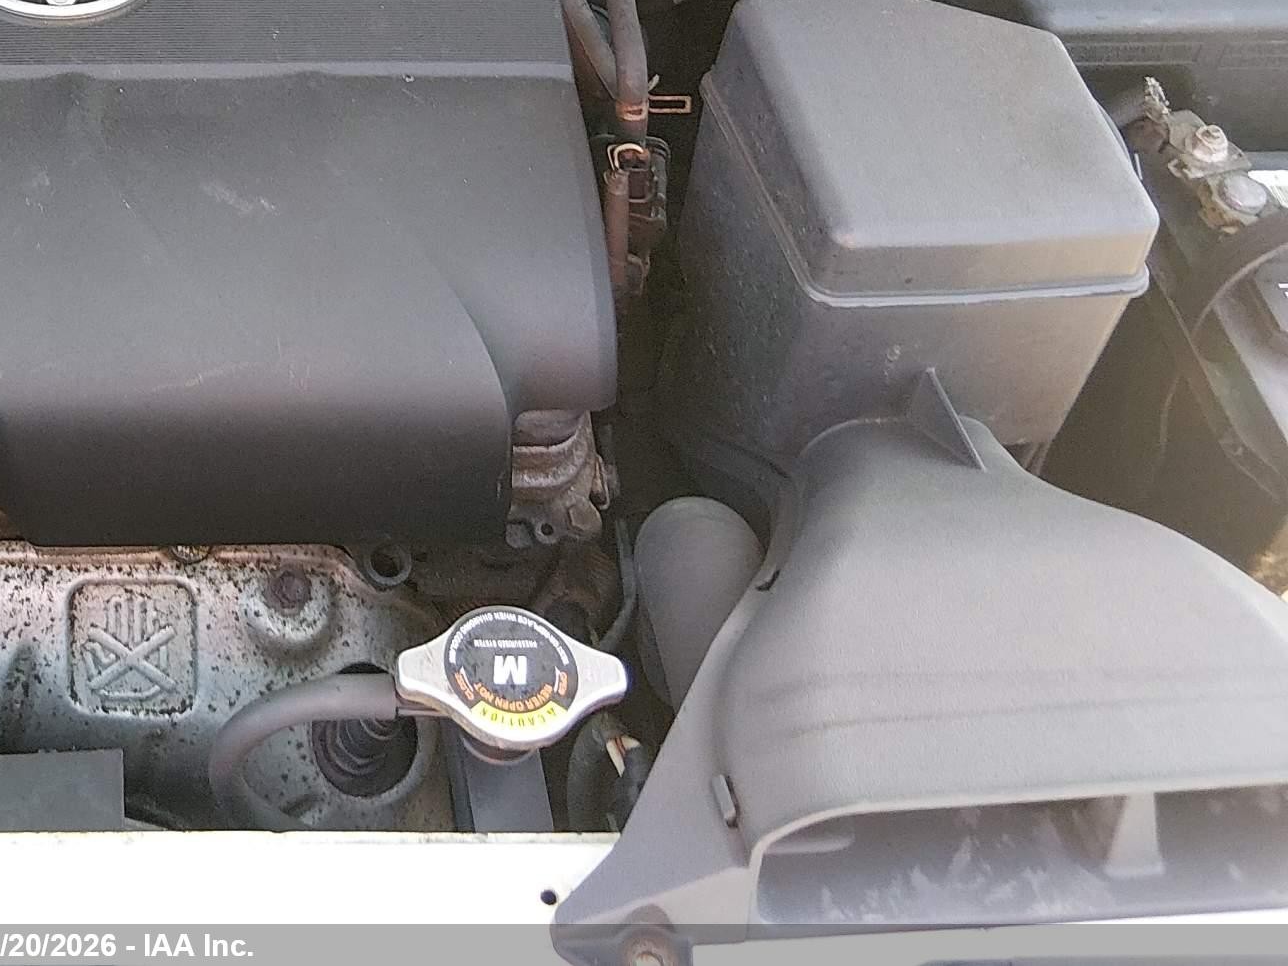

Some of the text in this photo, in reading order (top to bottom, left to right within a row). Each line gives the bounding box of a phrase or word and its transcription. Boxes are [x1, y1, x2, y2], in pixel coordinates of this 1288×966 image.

[493, 611, 517, 622] WHEN
[493, 655, 527, 685] M
[495, 696, 524, 712] OPEN
[526, 683, 552, 709] NEVER
[481, 707, 546, 726] CAUTION
